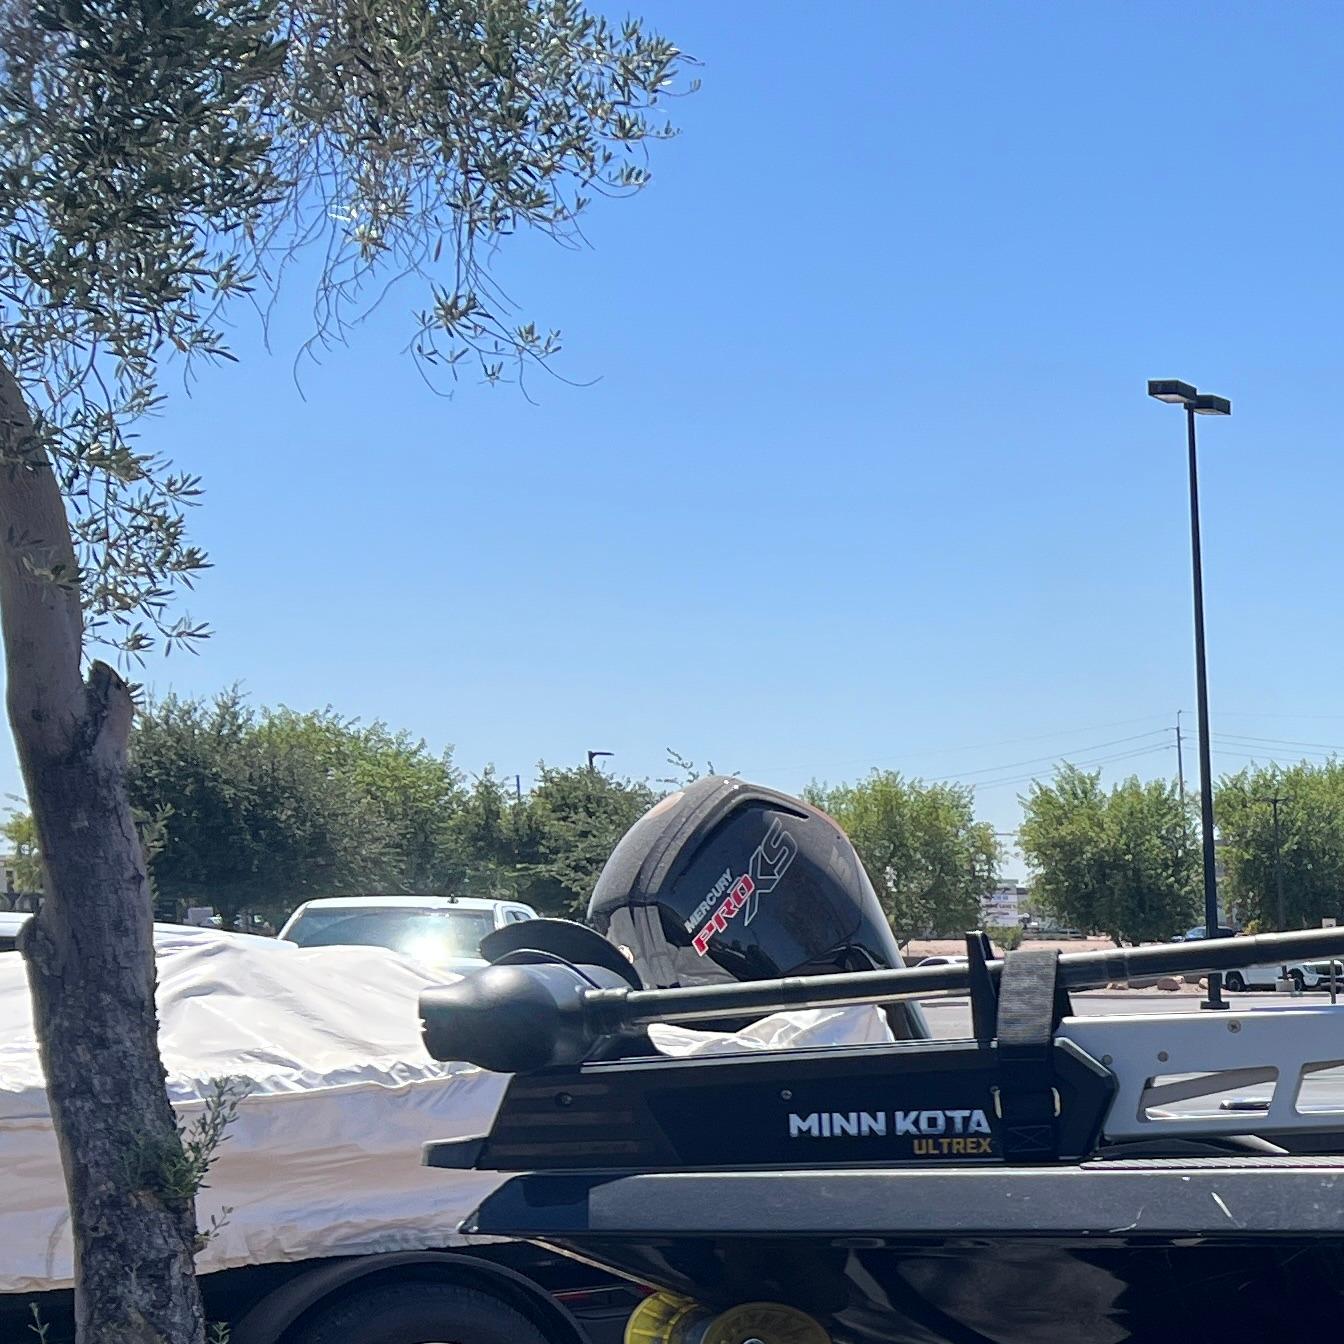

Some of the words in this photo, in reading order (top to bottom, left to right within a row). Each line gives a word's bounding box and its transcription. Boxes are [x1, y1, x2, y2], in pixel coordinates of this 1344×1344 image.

[684, 867, 733, 933] MERCURY
[692, 874, 755, 956] PRO
[788, 1111, 886, 1137] MINN
[895, 1109, 992, 1135] KOTA
[913, 1138, 992, 1154] ULTREX
